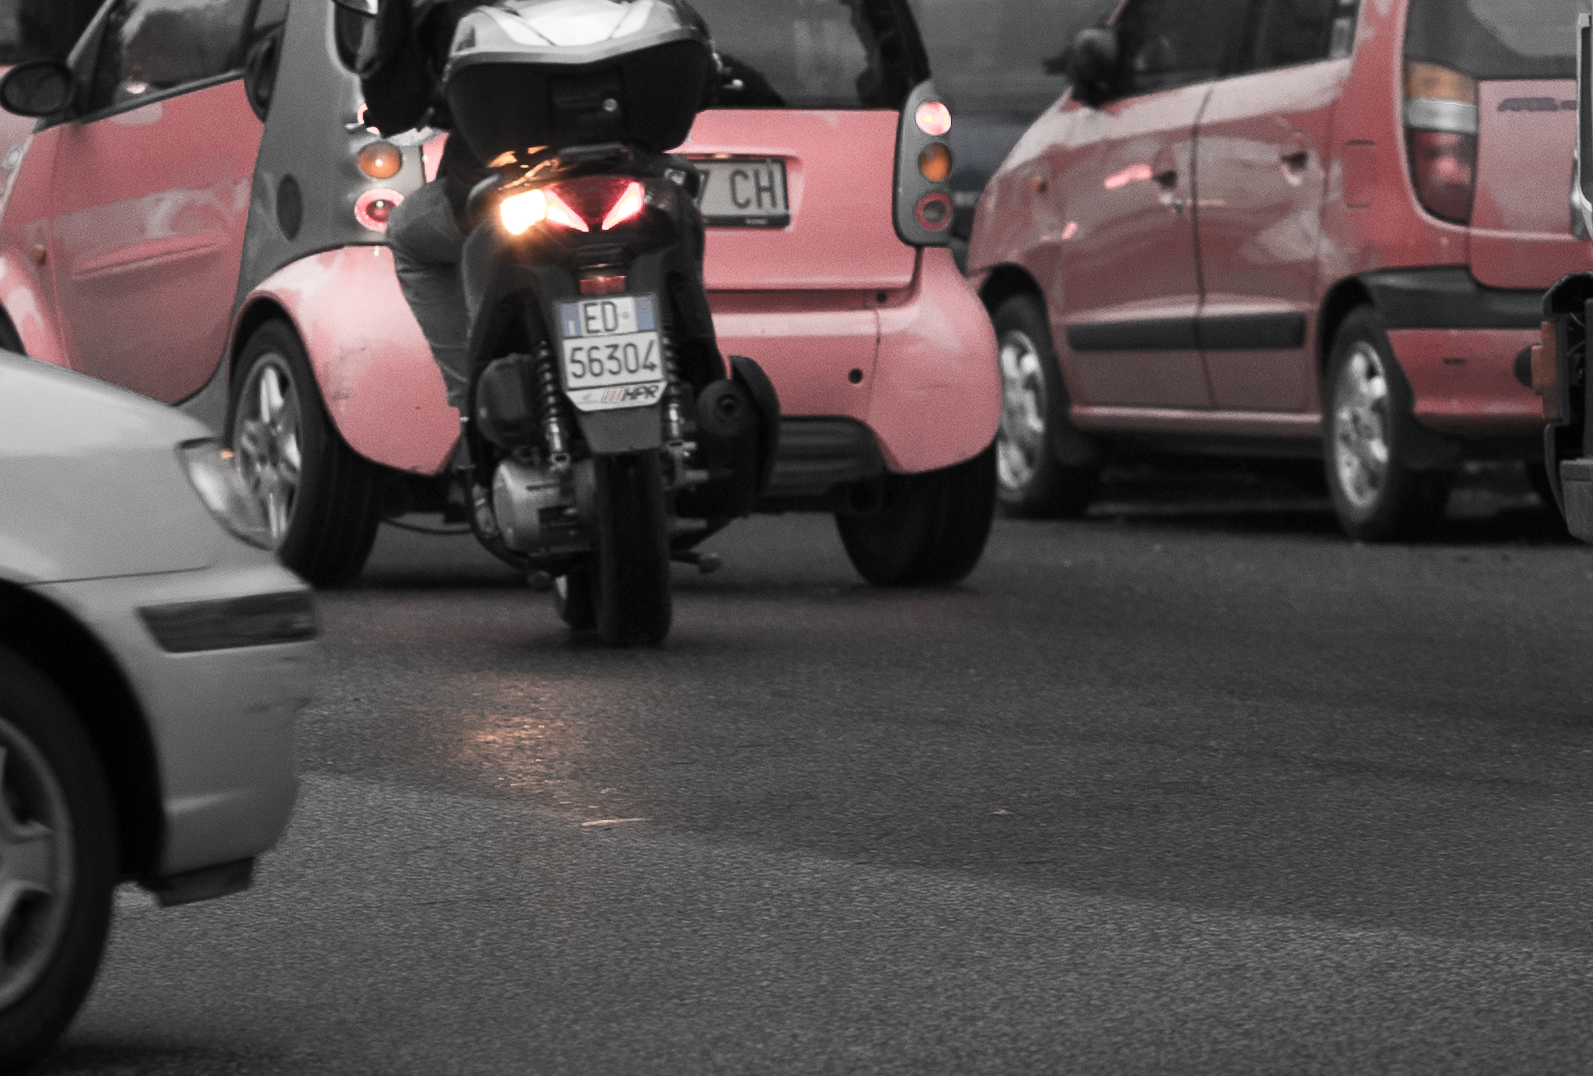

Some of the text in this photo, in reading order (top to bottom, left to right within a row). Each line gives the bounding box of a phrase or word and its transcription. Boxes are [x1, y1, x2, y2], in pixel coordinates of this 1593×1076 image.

[729, 169, 777, 209] CH
[584, 301, 619, 333] ED
[570, 340, 657, 378] 56304
